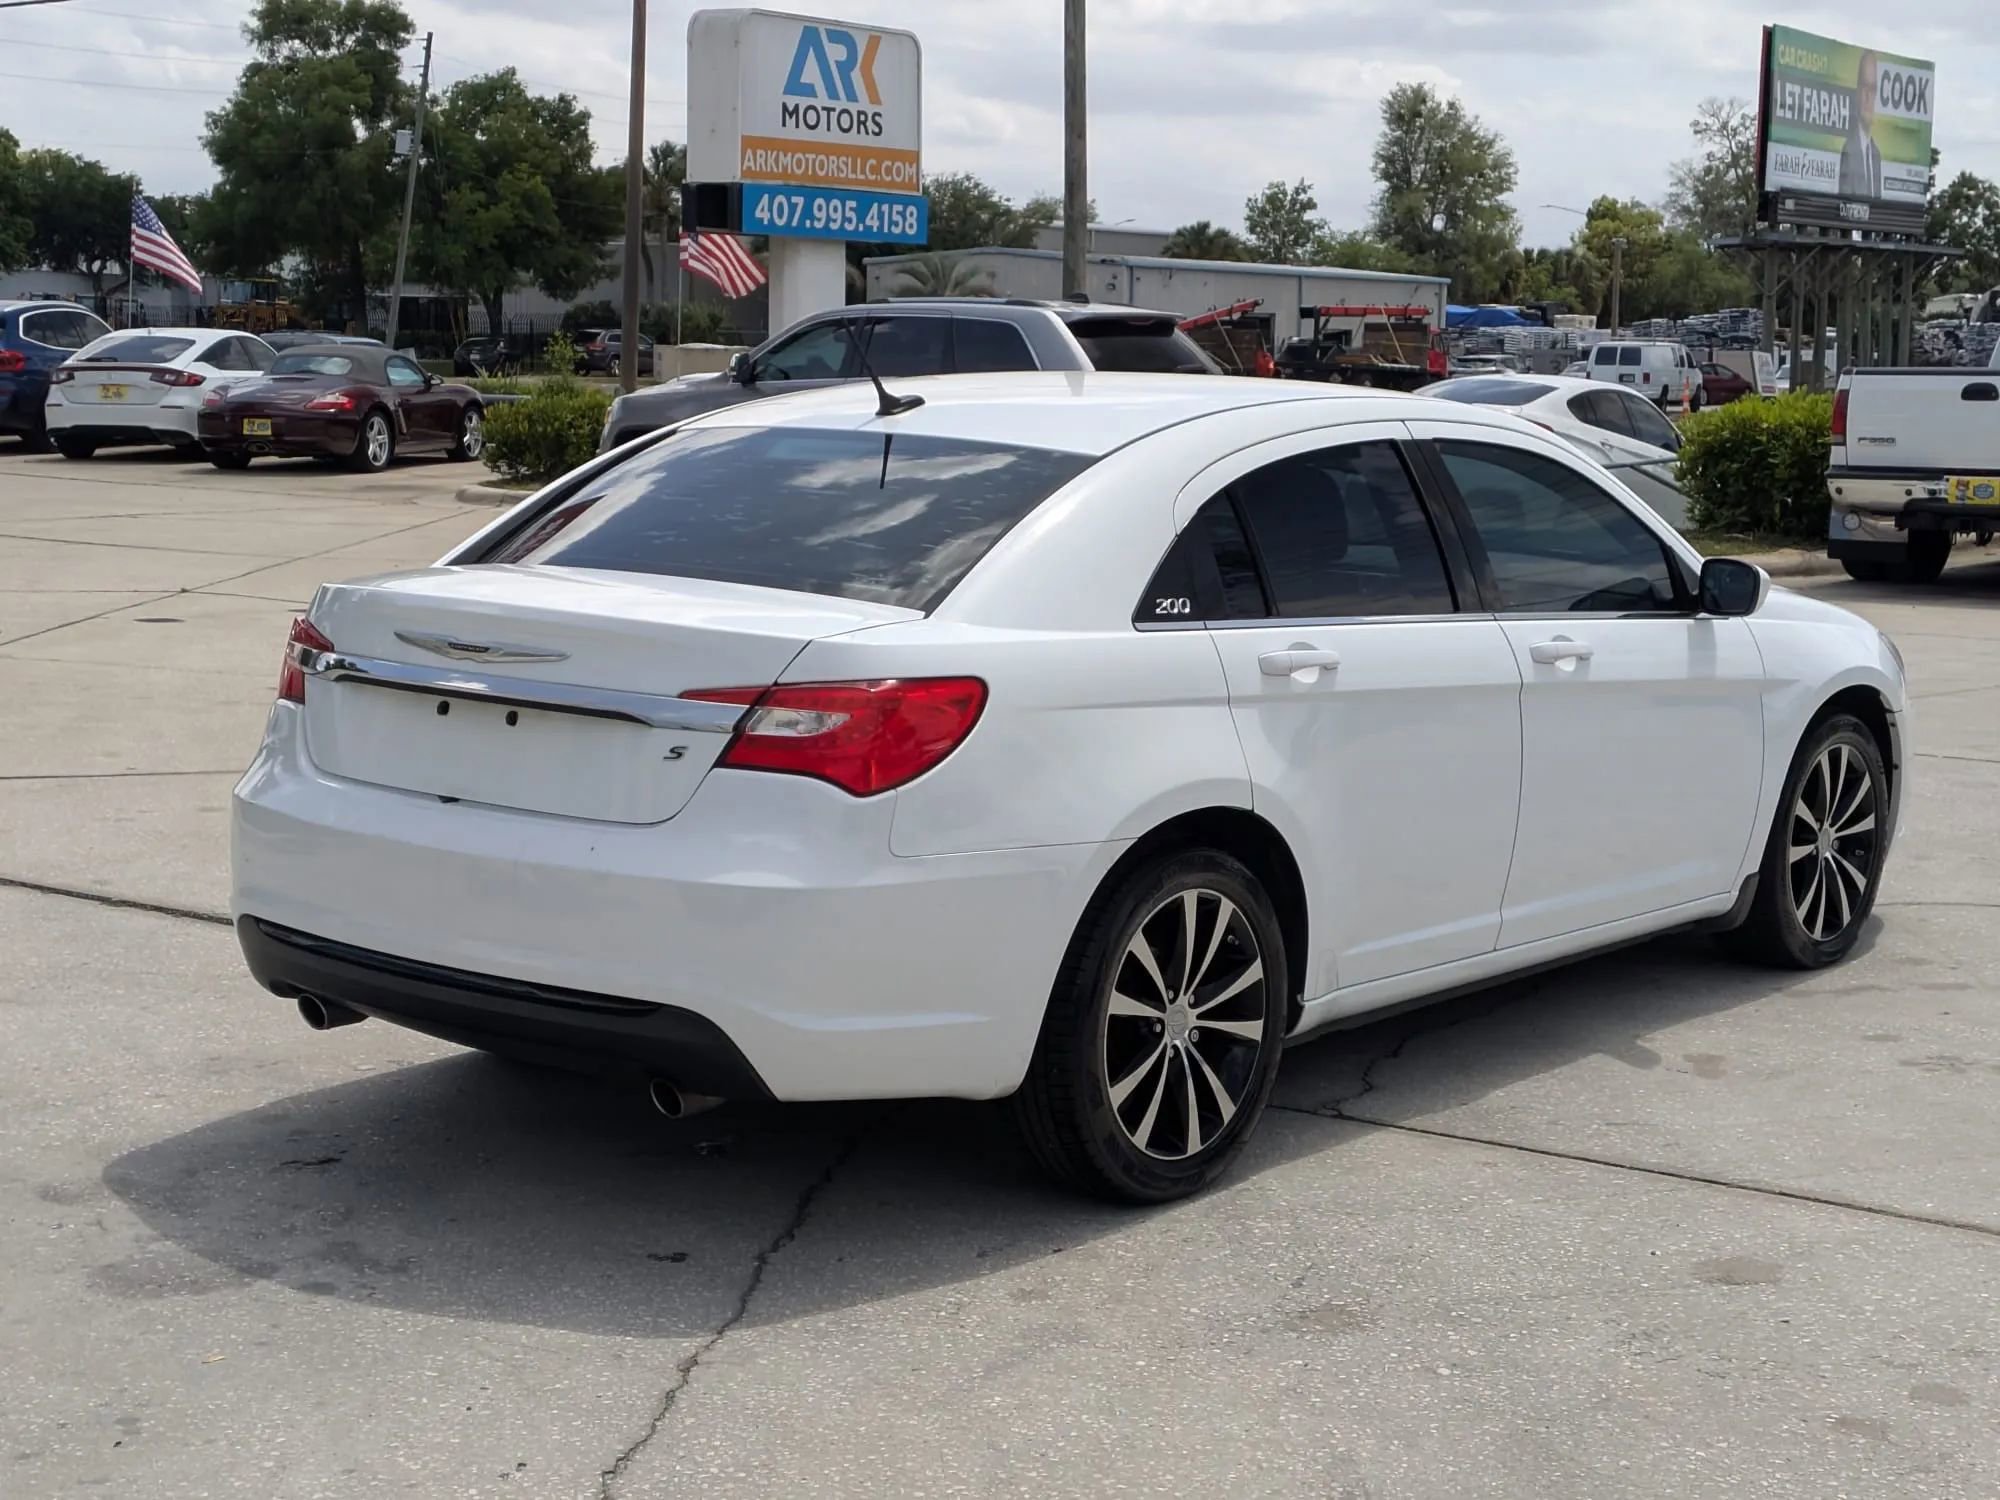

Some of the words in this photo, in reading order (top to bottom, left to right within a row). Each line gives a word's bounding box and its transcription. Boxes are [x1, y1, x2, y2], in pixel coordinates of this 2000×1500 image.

[782, 25, 882, 105] ARK
[1775, 80, 1800, 121] LET
[1802, 87, 1849, 130] FARAH
[1879, 69, 1930, 115] COOK
[781, 102, 882, 137] MOTORS
[743, 148, 917, 184] ARKMOTORSLLC.COM
[1774, 152, 1800, 175] FARAH
[1811, 159, 1836, 180] FARAH
[755, 193, 918, 235] 407.995.4158
[1155, 597, 1190, 614] 200
[663, 746, 688, 760] S
